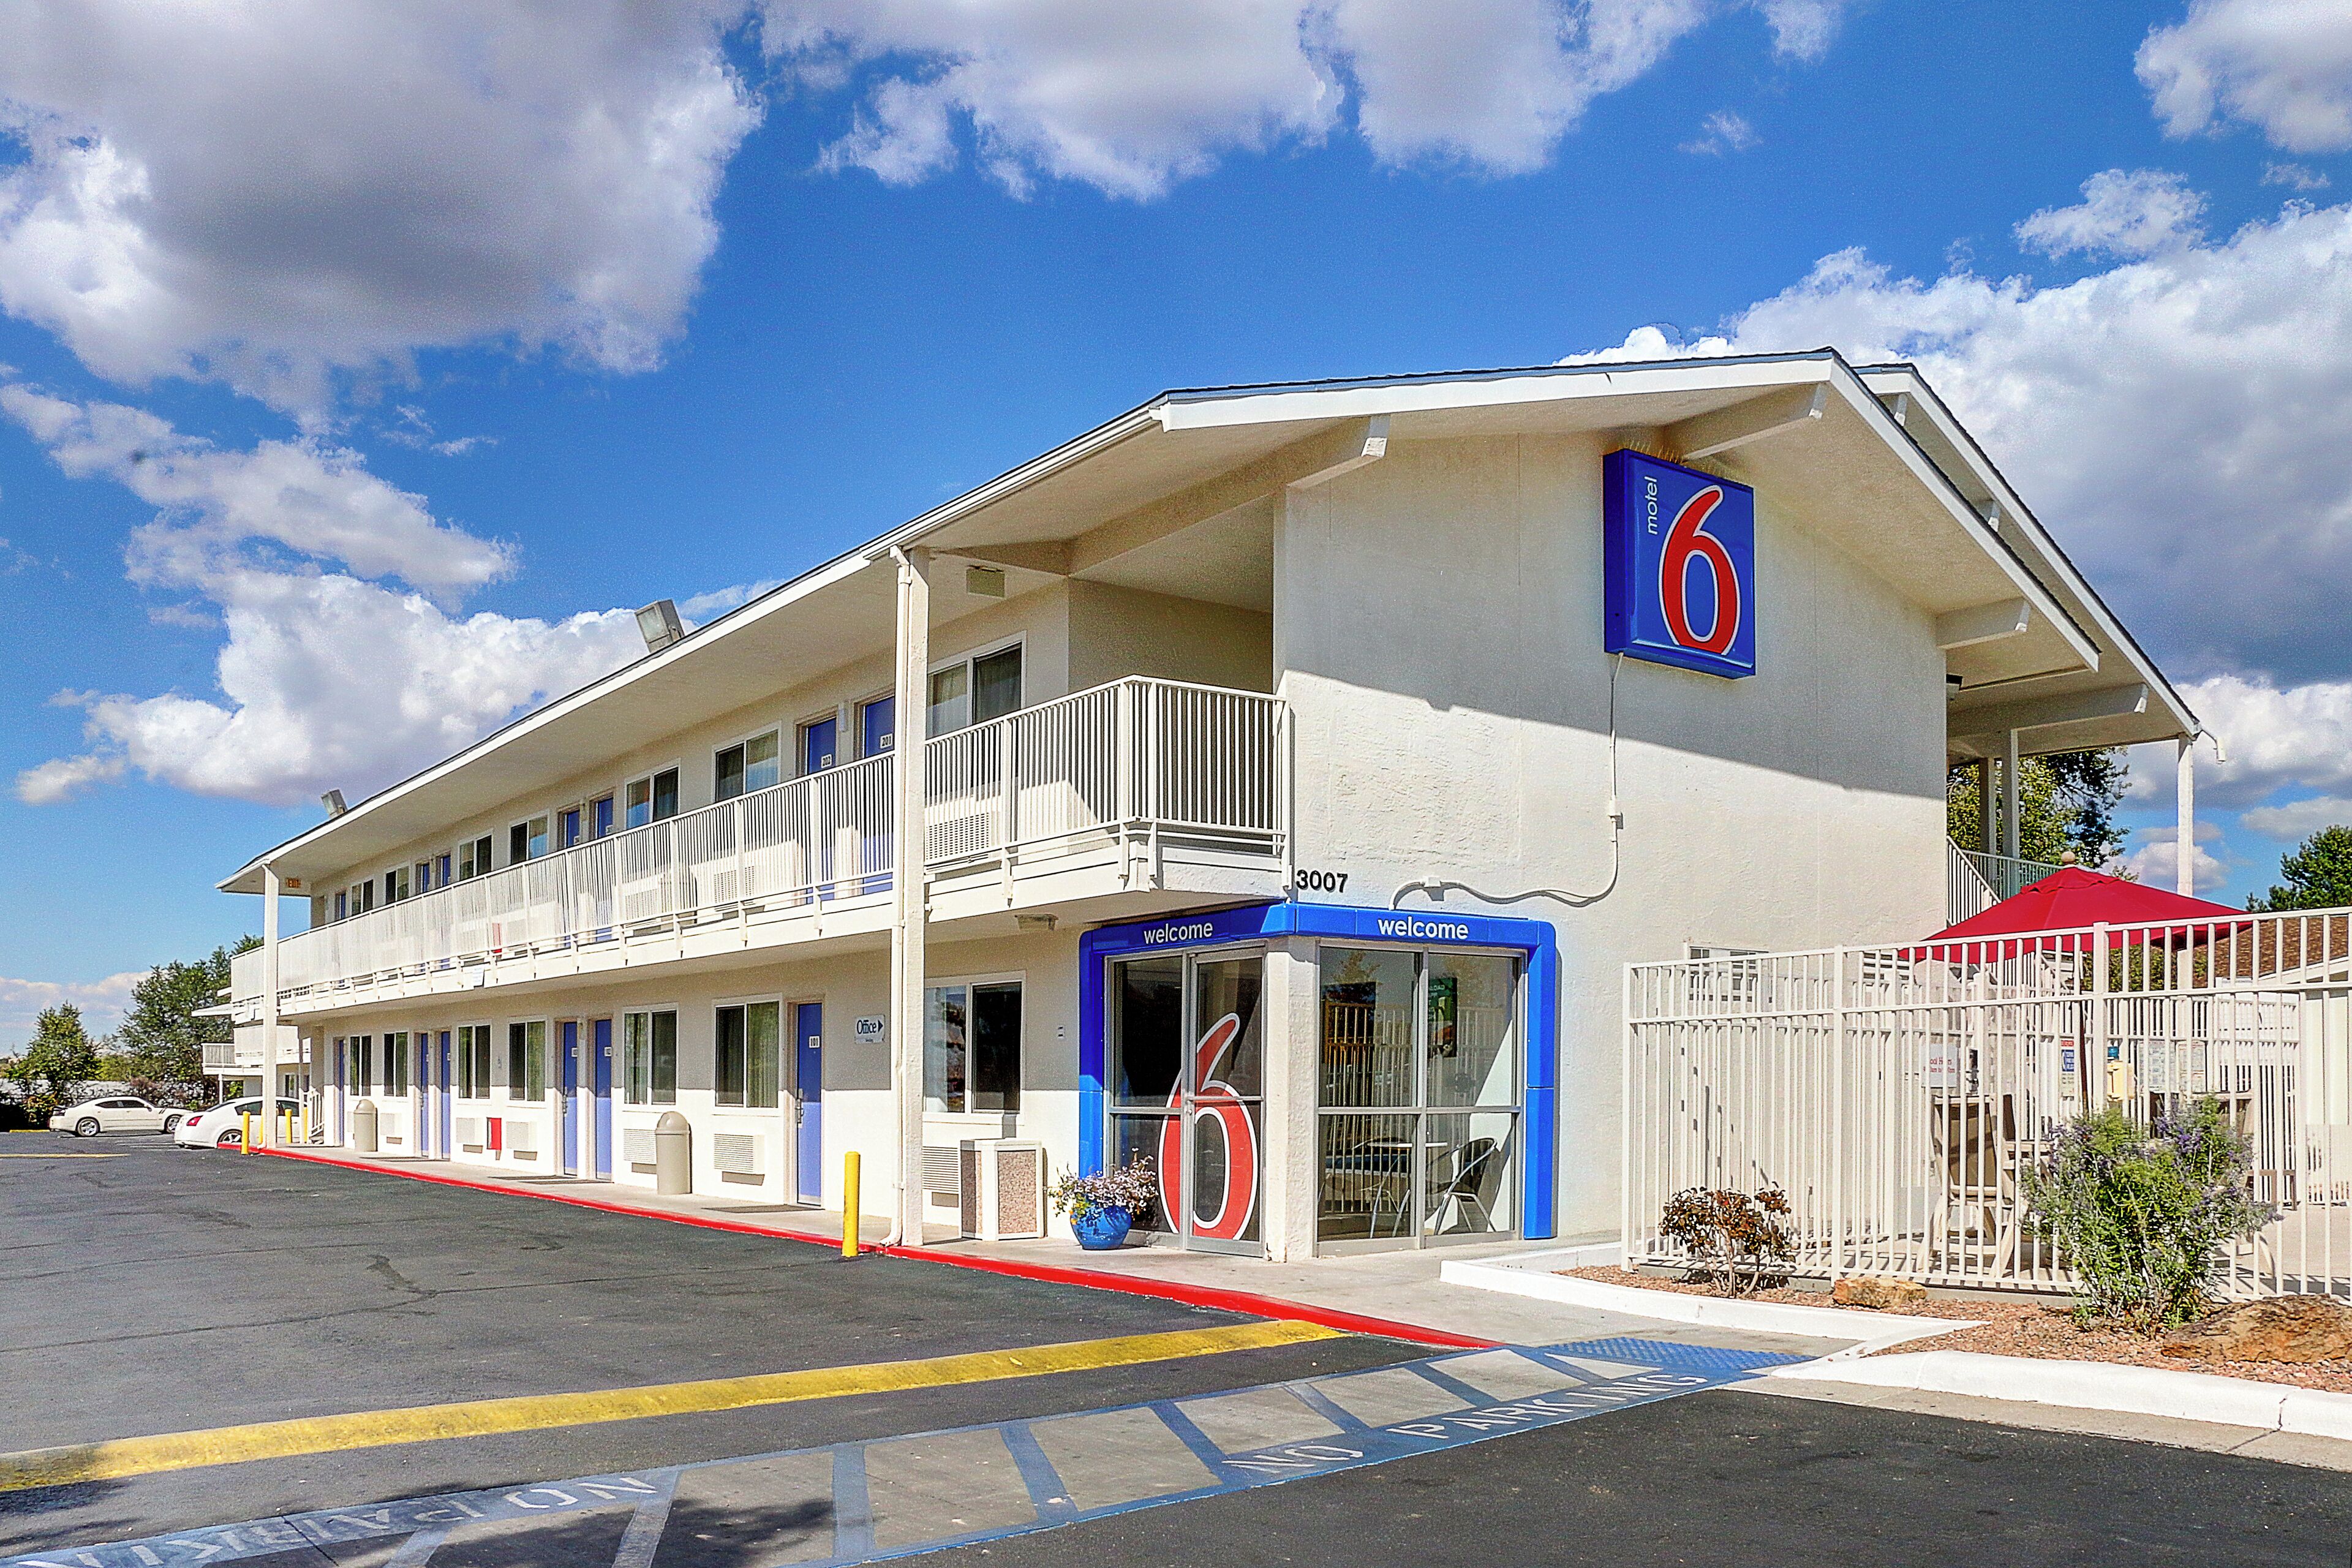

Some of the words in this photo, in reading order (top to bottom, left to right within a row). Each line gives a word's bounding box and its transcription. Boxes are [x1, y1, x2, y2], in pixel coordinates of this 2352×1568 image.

[1645, 476, 1657, 535] motel
[1658, 484, 1741, 656] 6
[881, 736, 892, 747] 201
[1295, 869, 1348, 893] 3007
[1143, 921, 1213, 944] welcome
[1378, 916, 1469, 940] welcome
[857, 1019, 876, 1035] Office
[810, 1038, 819, 1047] 101
[1158, 1012, 1258, 1241] 6
[1222, 1445, 1364, 1474] NO
[1386, 1374, 1708, 1439] PARKING
[502, 1477, 658, 1509] NO
